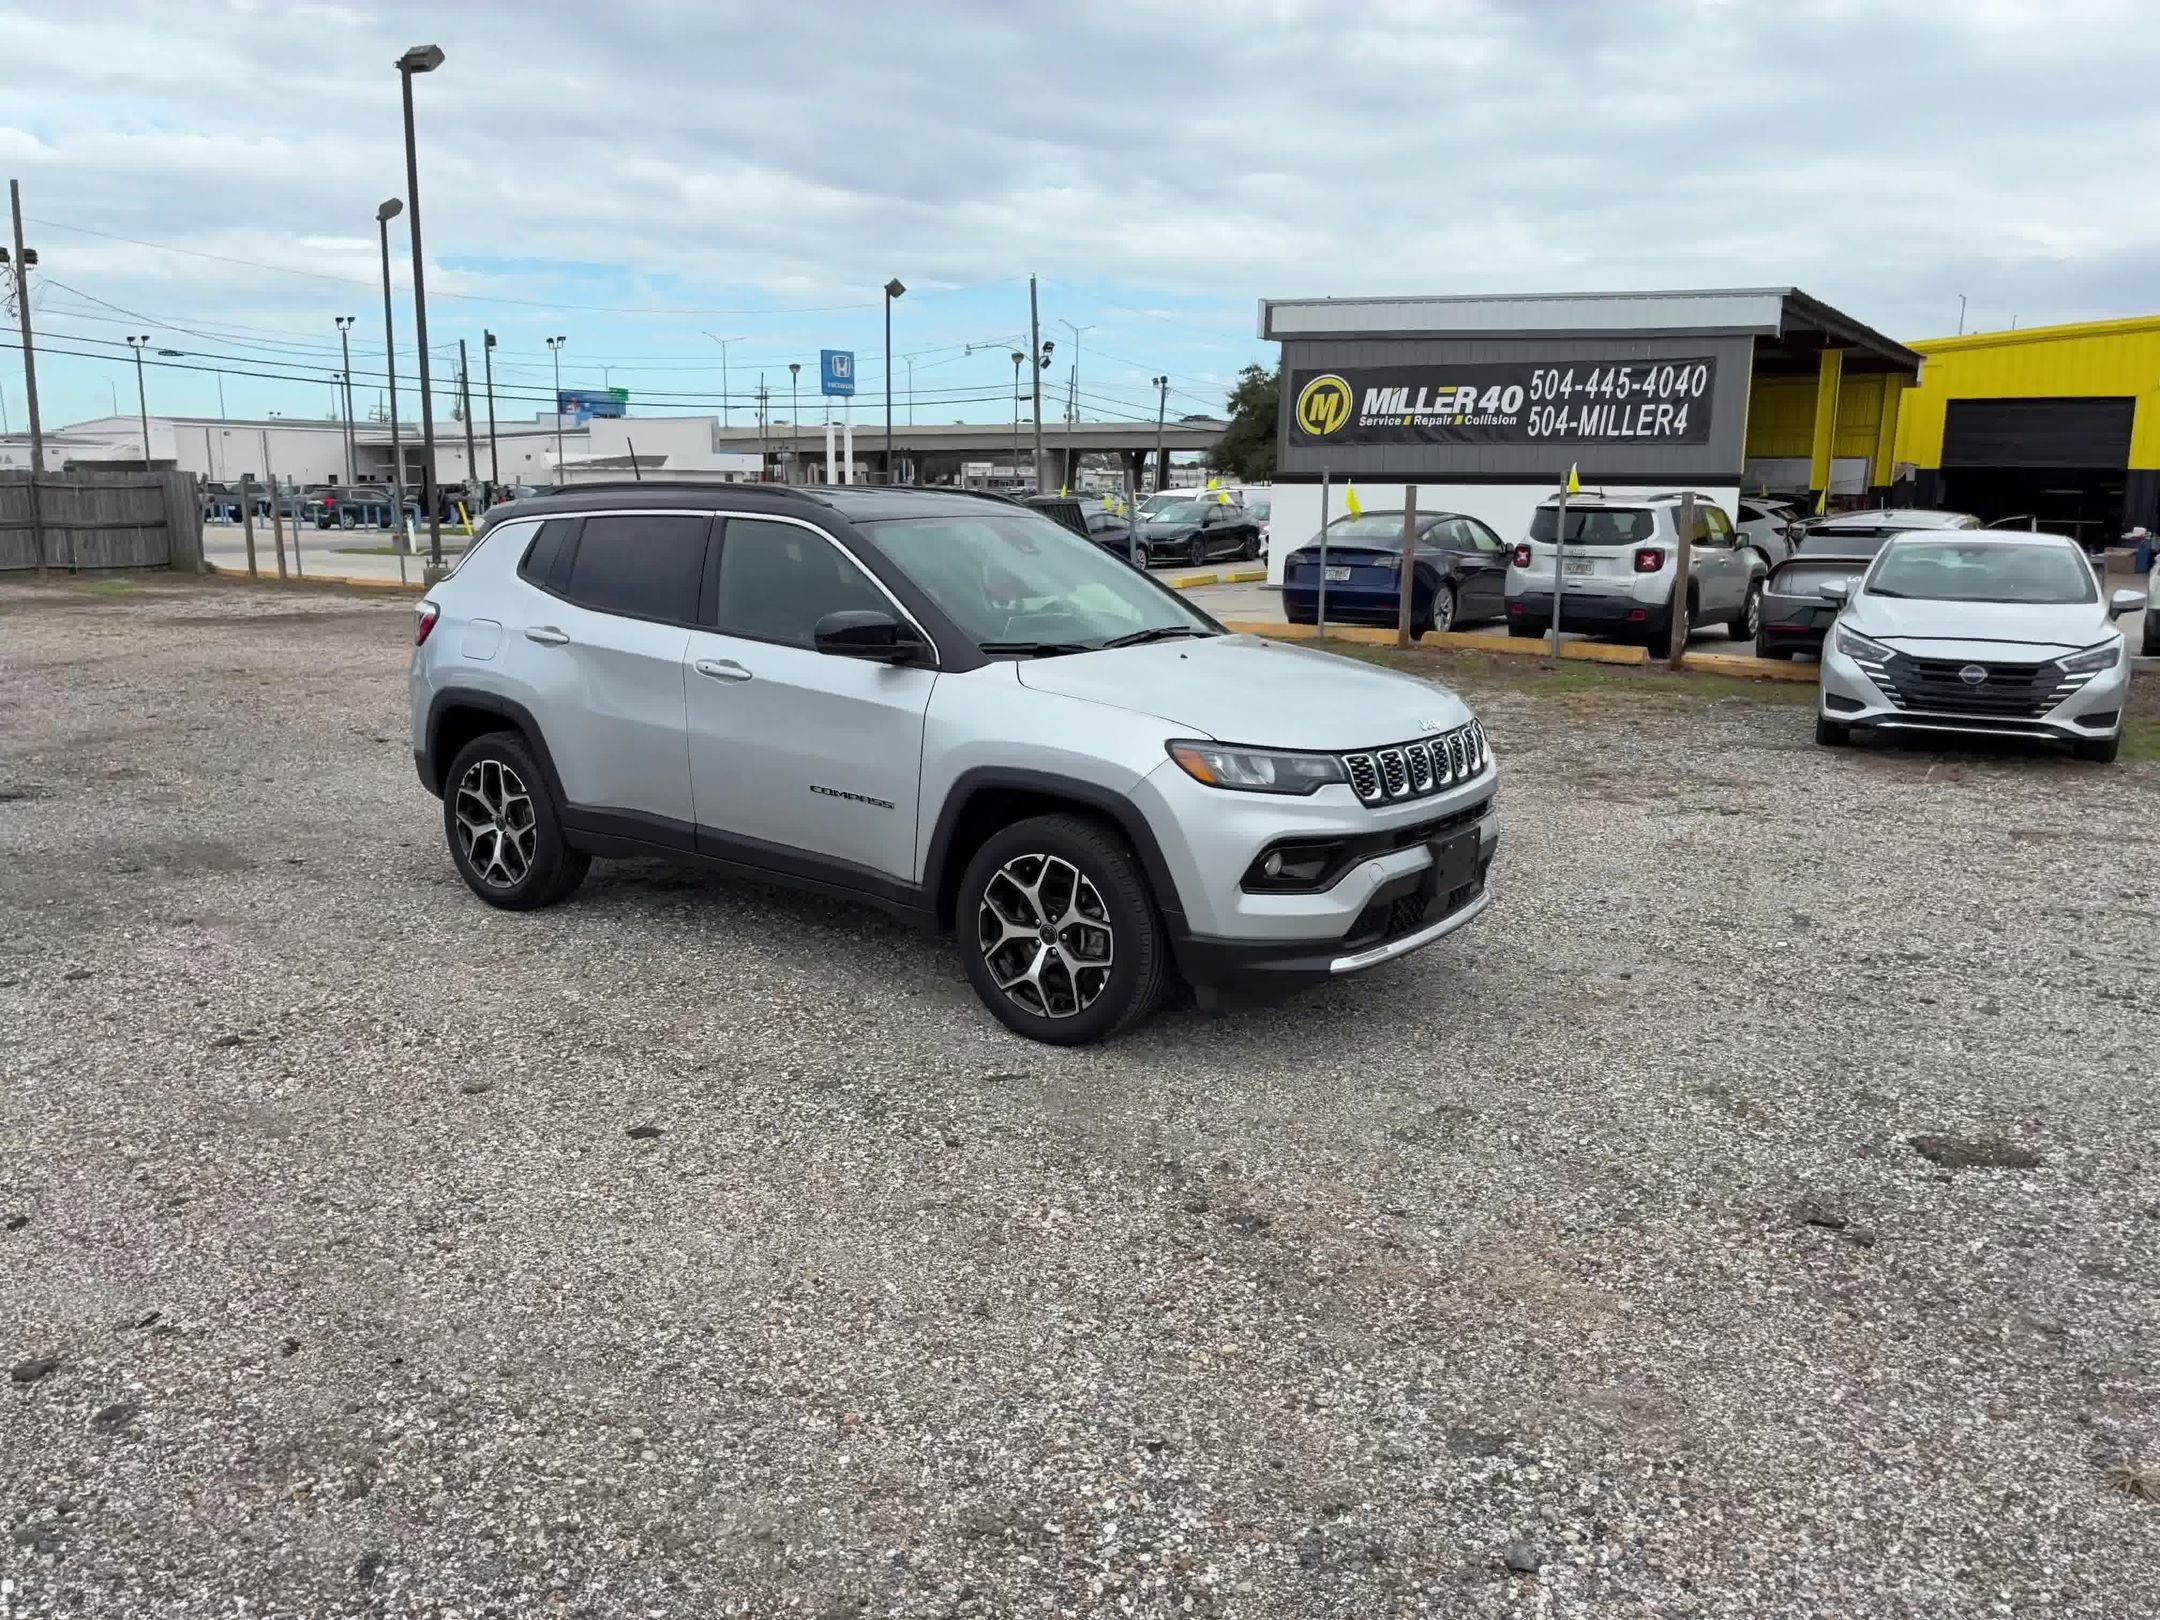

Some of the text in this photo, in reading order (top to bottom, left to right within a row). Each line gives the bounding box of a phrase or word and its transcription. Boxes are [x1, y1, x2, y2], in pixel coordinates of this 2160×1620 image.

[1529, 365, 1707, 400] 504-445-4040
[1358, 414, 1518, 428] Service Repair Collision
[1527, 403, 1689, 437] 504-MILLER4
[809, 785, 895, 809] COMPASS
